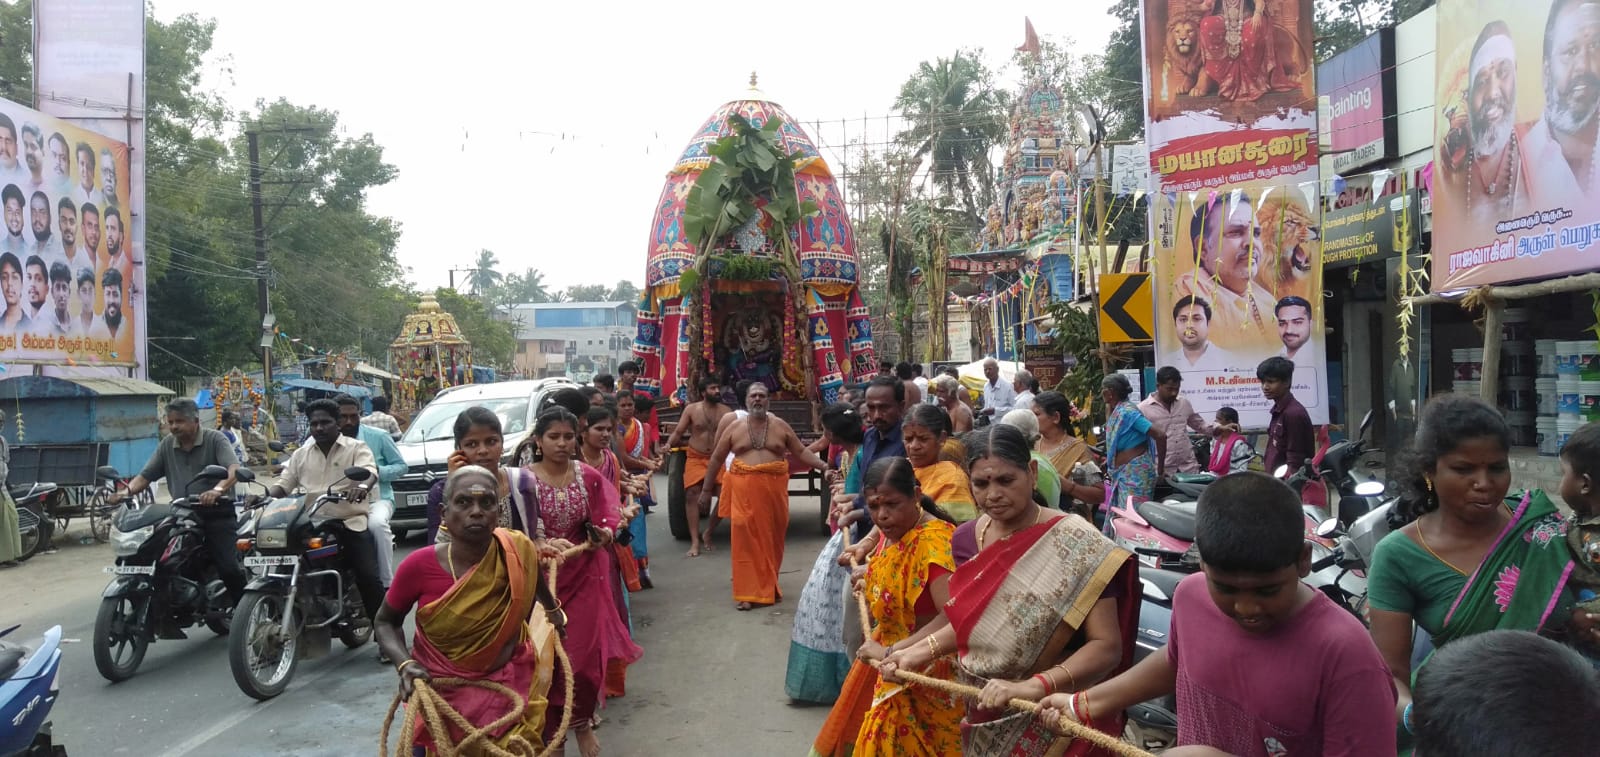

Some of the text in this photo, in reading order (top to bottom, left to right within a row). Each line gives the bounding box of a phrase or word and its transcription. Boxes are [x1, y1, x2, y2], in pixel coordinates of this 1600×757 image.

[1329, 87, 1371, 120] painting
[1351, 144, 1376, 162] TRADERS
[1323, 231, 1375, 251] RANDMASTE OF
[1449, 234, 1516, 273] ராஜவாகினி
[1517, 227, 1556, 258] அருள்
[22, 332, 55, 349] அம்மன்
[58, 335, 82, 353] அருள்
